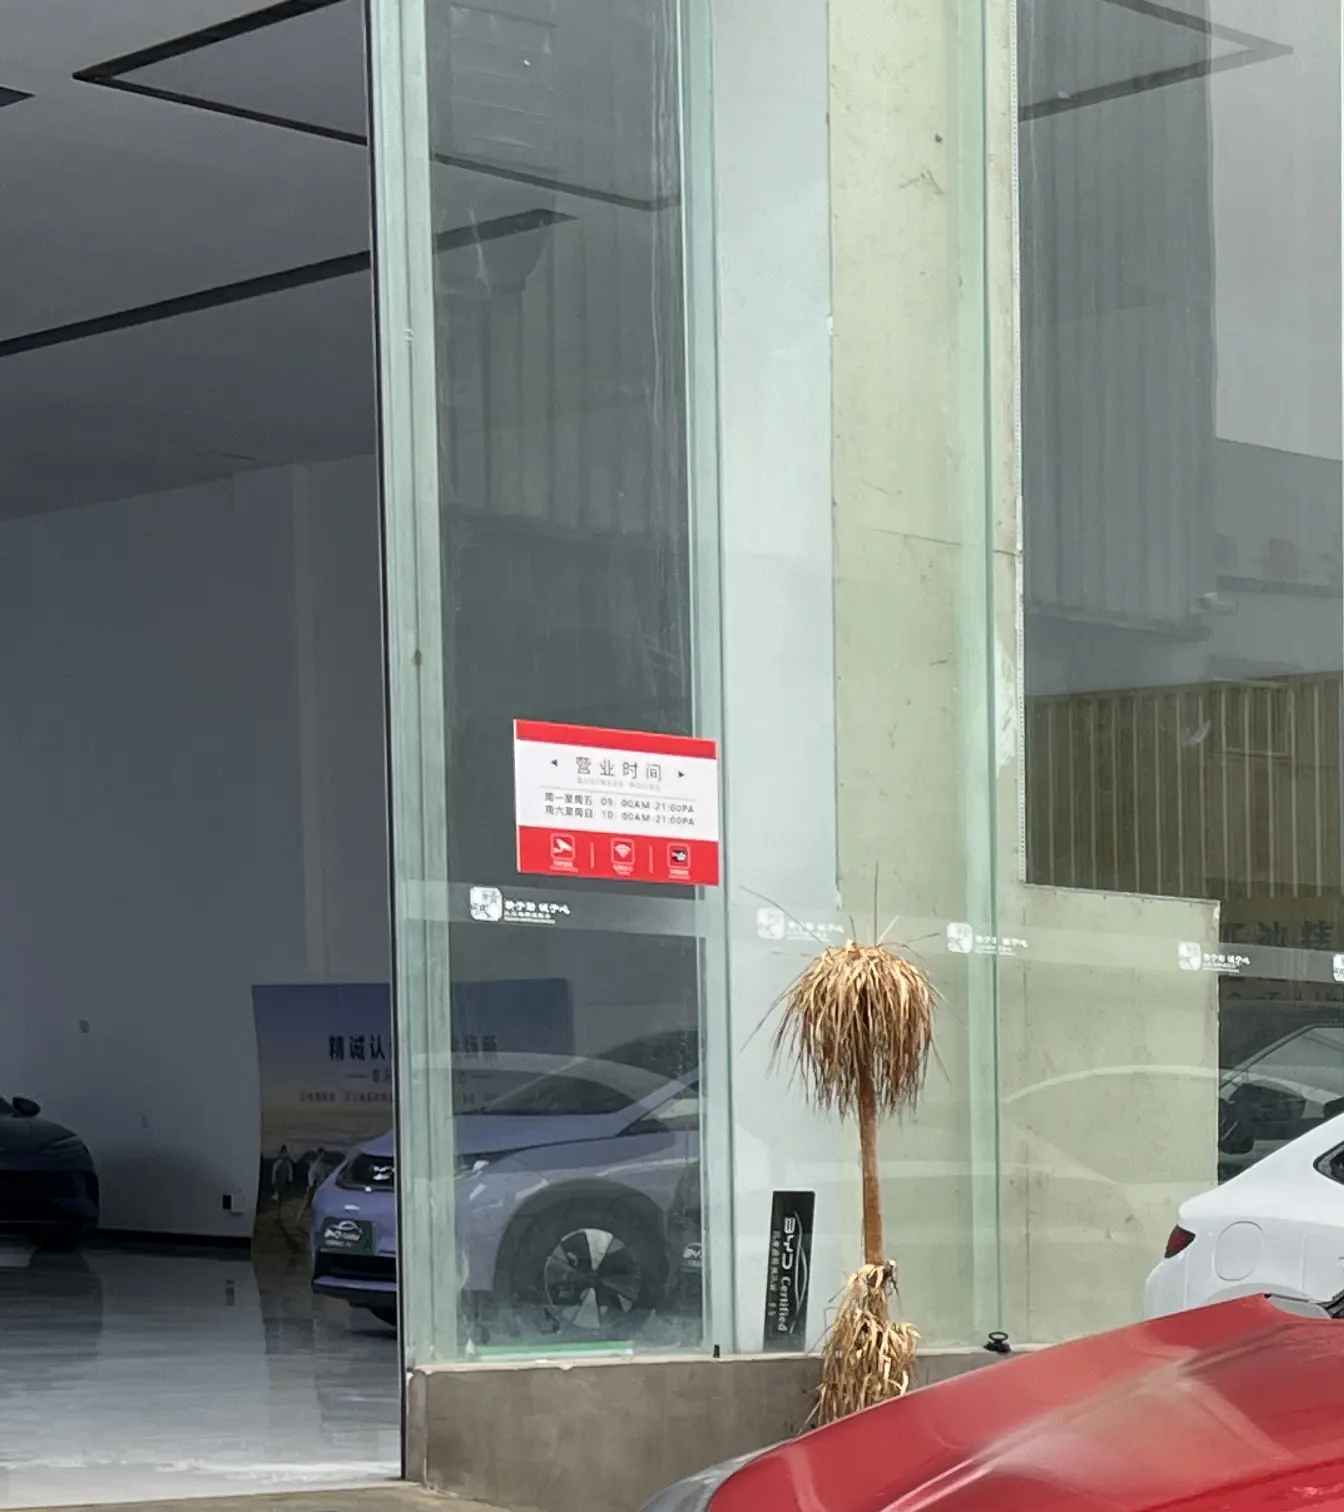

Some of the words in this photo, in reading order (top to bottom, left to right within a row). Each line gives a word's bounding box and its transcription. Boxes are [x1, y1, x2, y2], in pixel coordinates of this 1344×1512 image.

[576, 757, 661, 782] 营业时间
[545, 792, 592, 805] 周一至周五
[546, 805, 593, 819] 周六至周日
[782, 1217, 796, 1270] BYD
[777, 1276, 791, 1332] Certified
